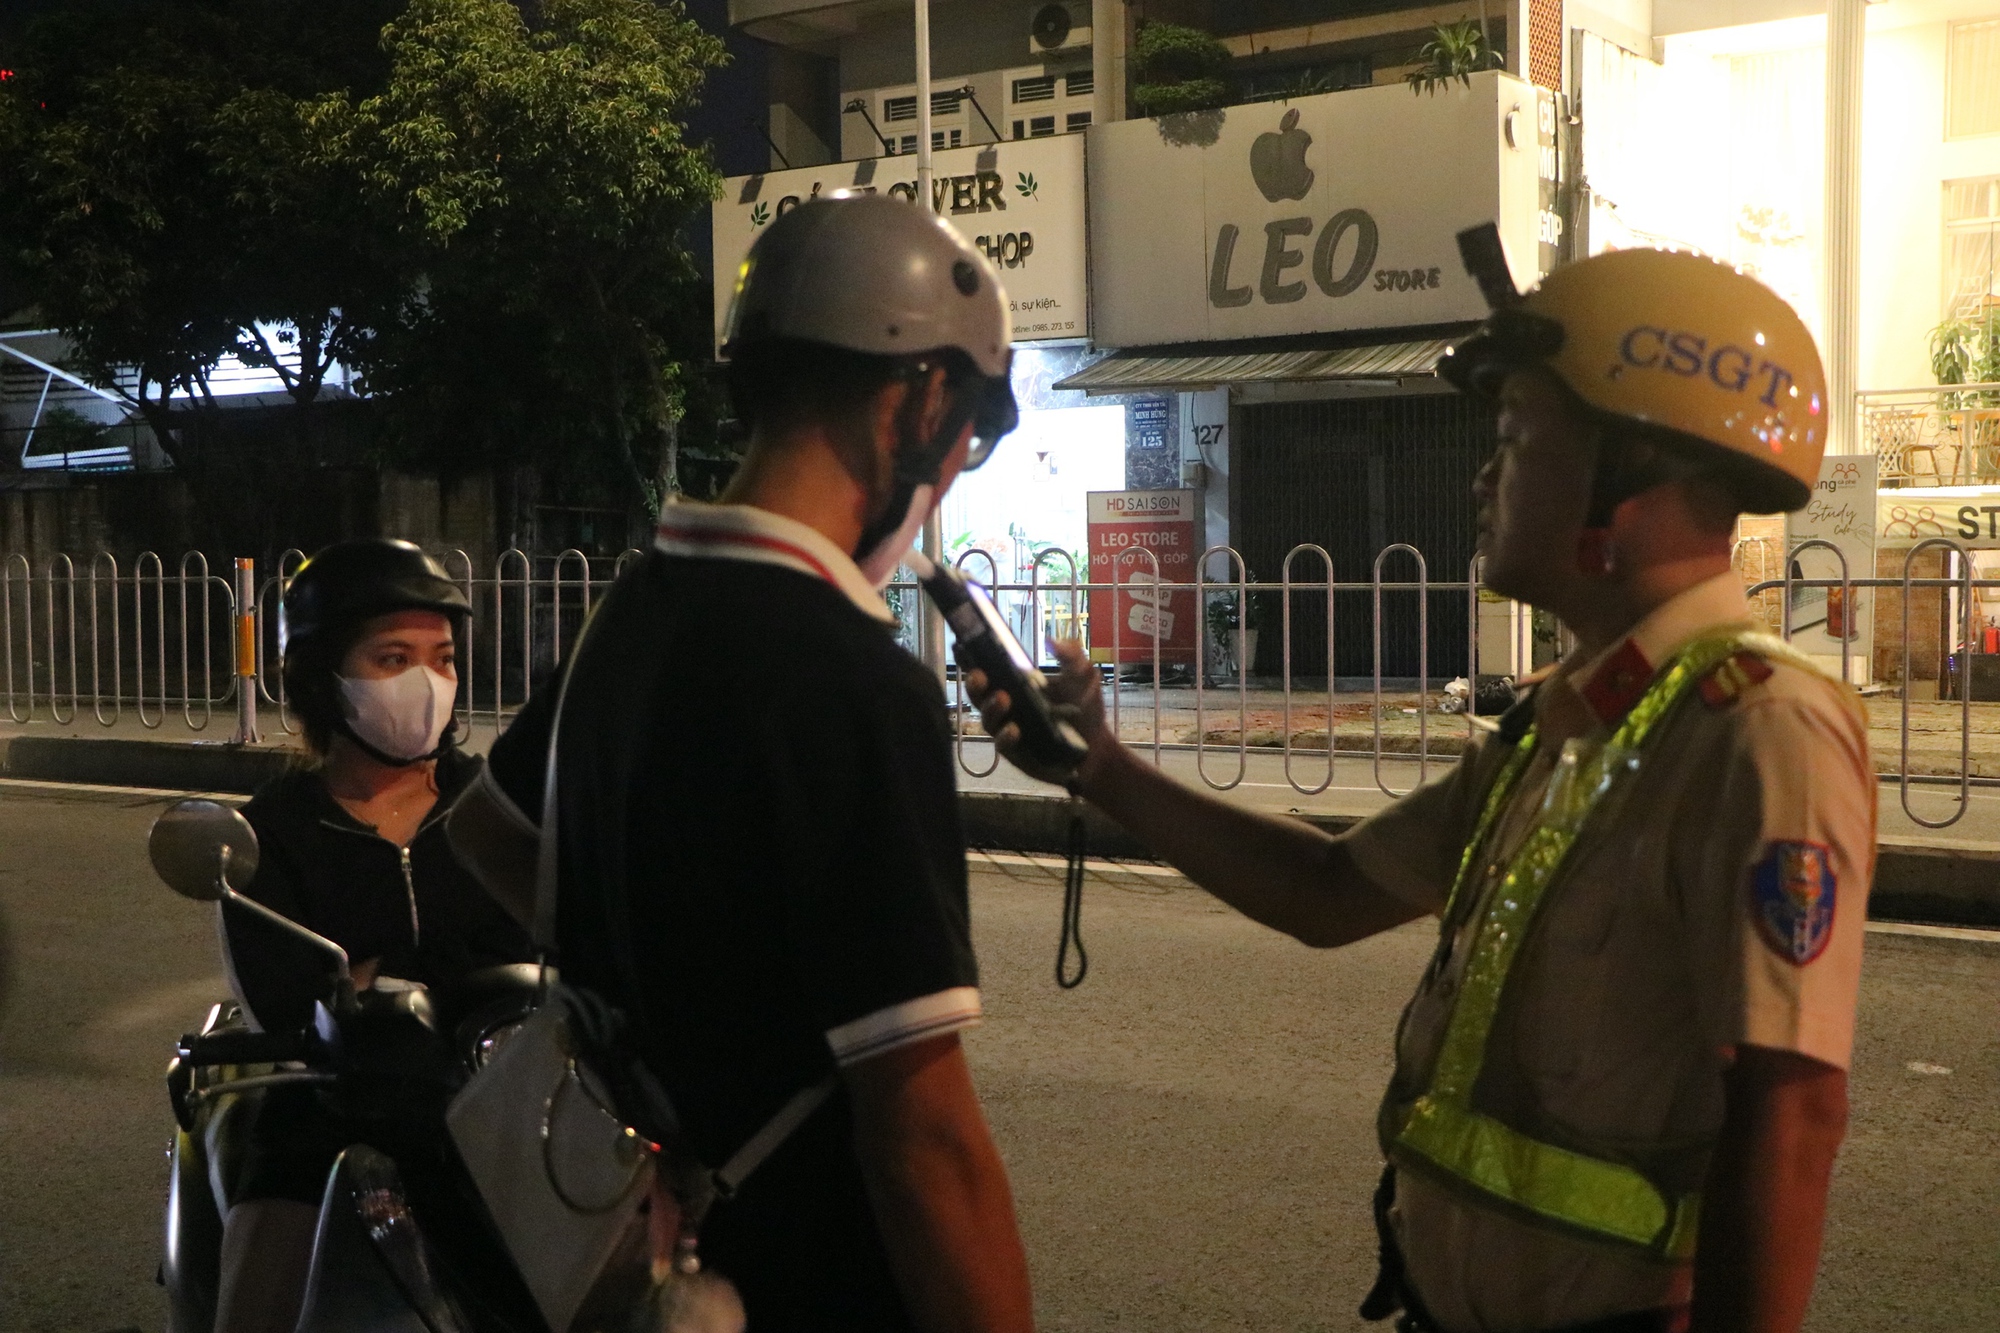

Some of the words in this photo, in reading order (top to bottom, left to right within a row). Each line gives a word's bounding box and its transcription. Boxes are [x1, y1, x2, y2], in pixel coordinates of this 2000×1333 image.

[1209, 208, 1379, 309] LEO
[1373, 267, 1440, 292] STORE
[1021, 301, 1034, 312] sự
[1620, 325, 1794, 409] CSGT
[1142, 435, 1163, 447] 125
[1191, 424, 1224, 445] 127
[1106, 498, 1125, 511] HD
[1127, 496, 1180, 510] SAISON
[1807, 500, 1857, 525] Study
[1101, 533, 1129, 547] LEO
[1132, 531, 1179, 546] STORE
[1163, 551, 1188, 564] GÓP
